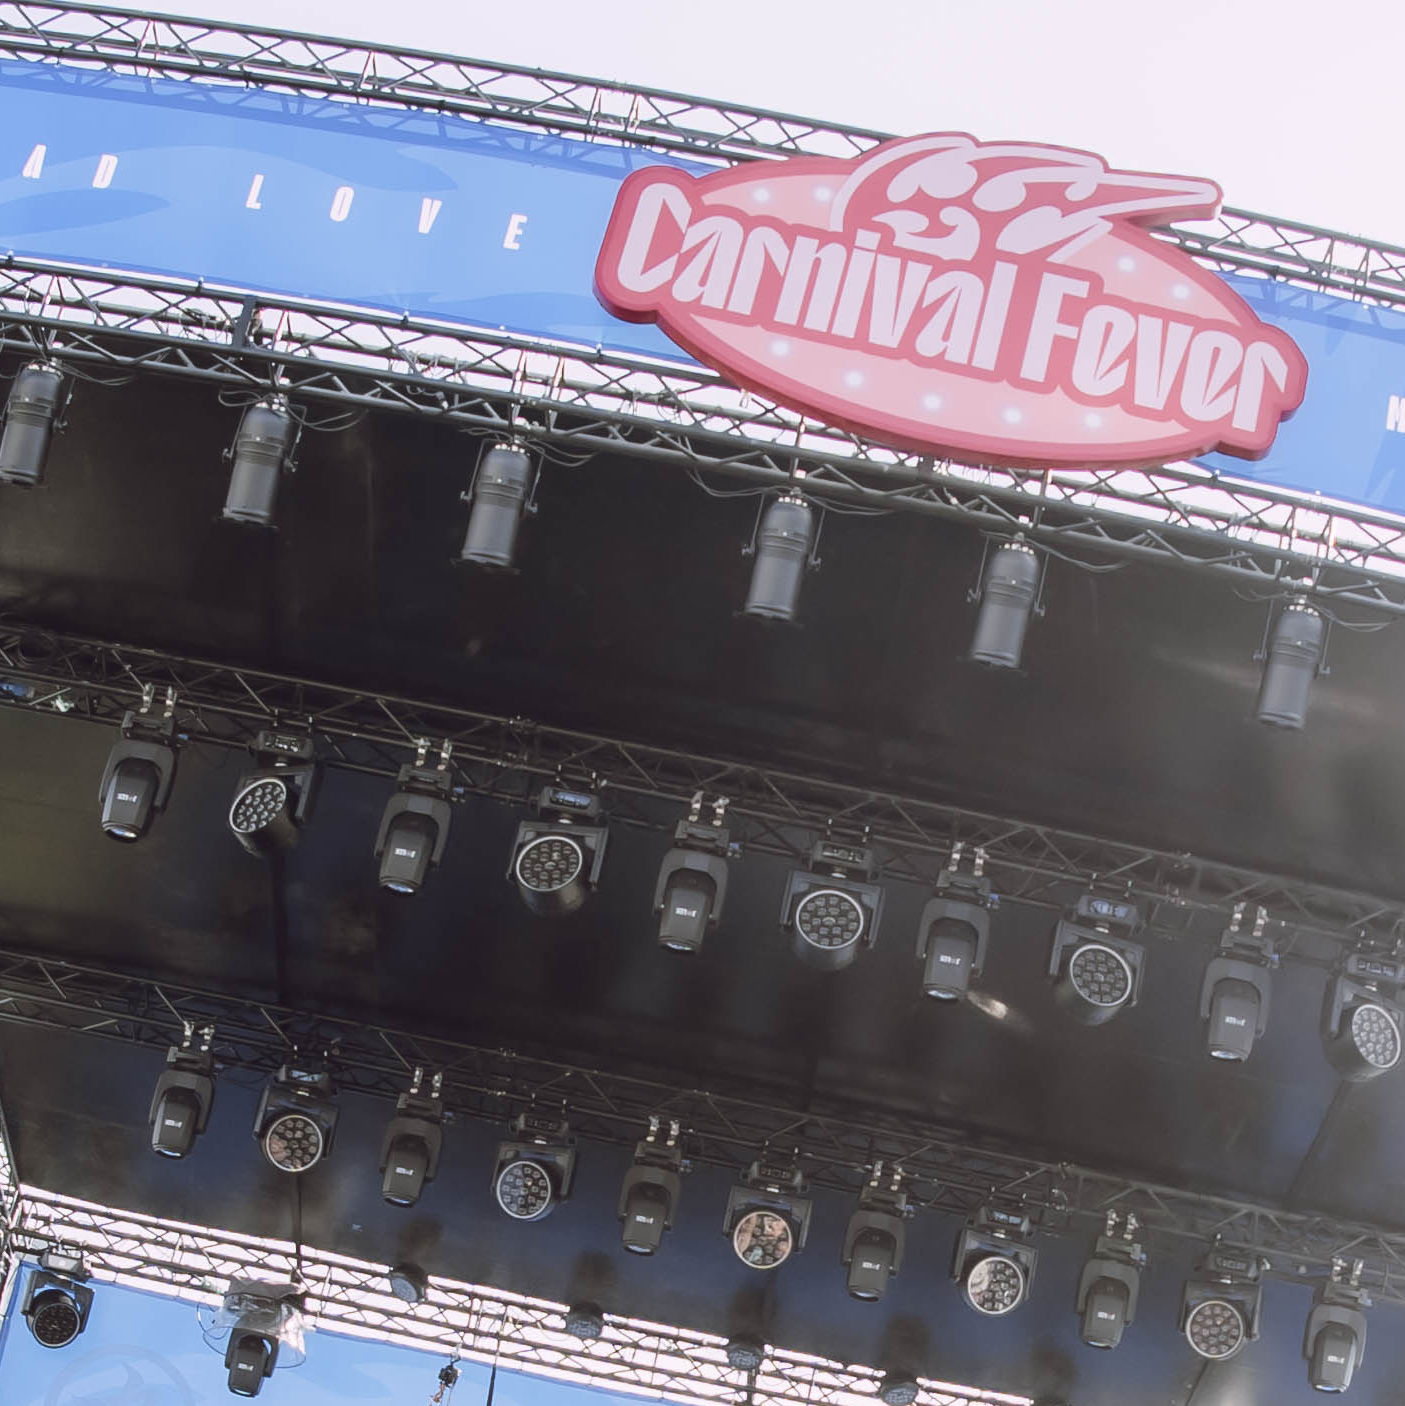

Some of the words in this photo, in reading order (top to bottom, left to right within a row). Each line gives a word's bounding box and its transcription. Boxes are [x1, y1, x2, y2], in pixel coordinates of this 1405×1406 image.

[245, 174, 527, 251] LOVE
[617, 183, 1018, 372] Carnival
[1020, 272, 1289, 433] Fever
